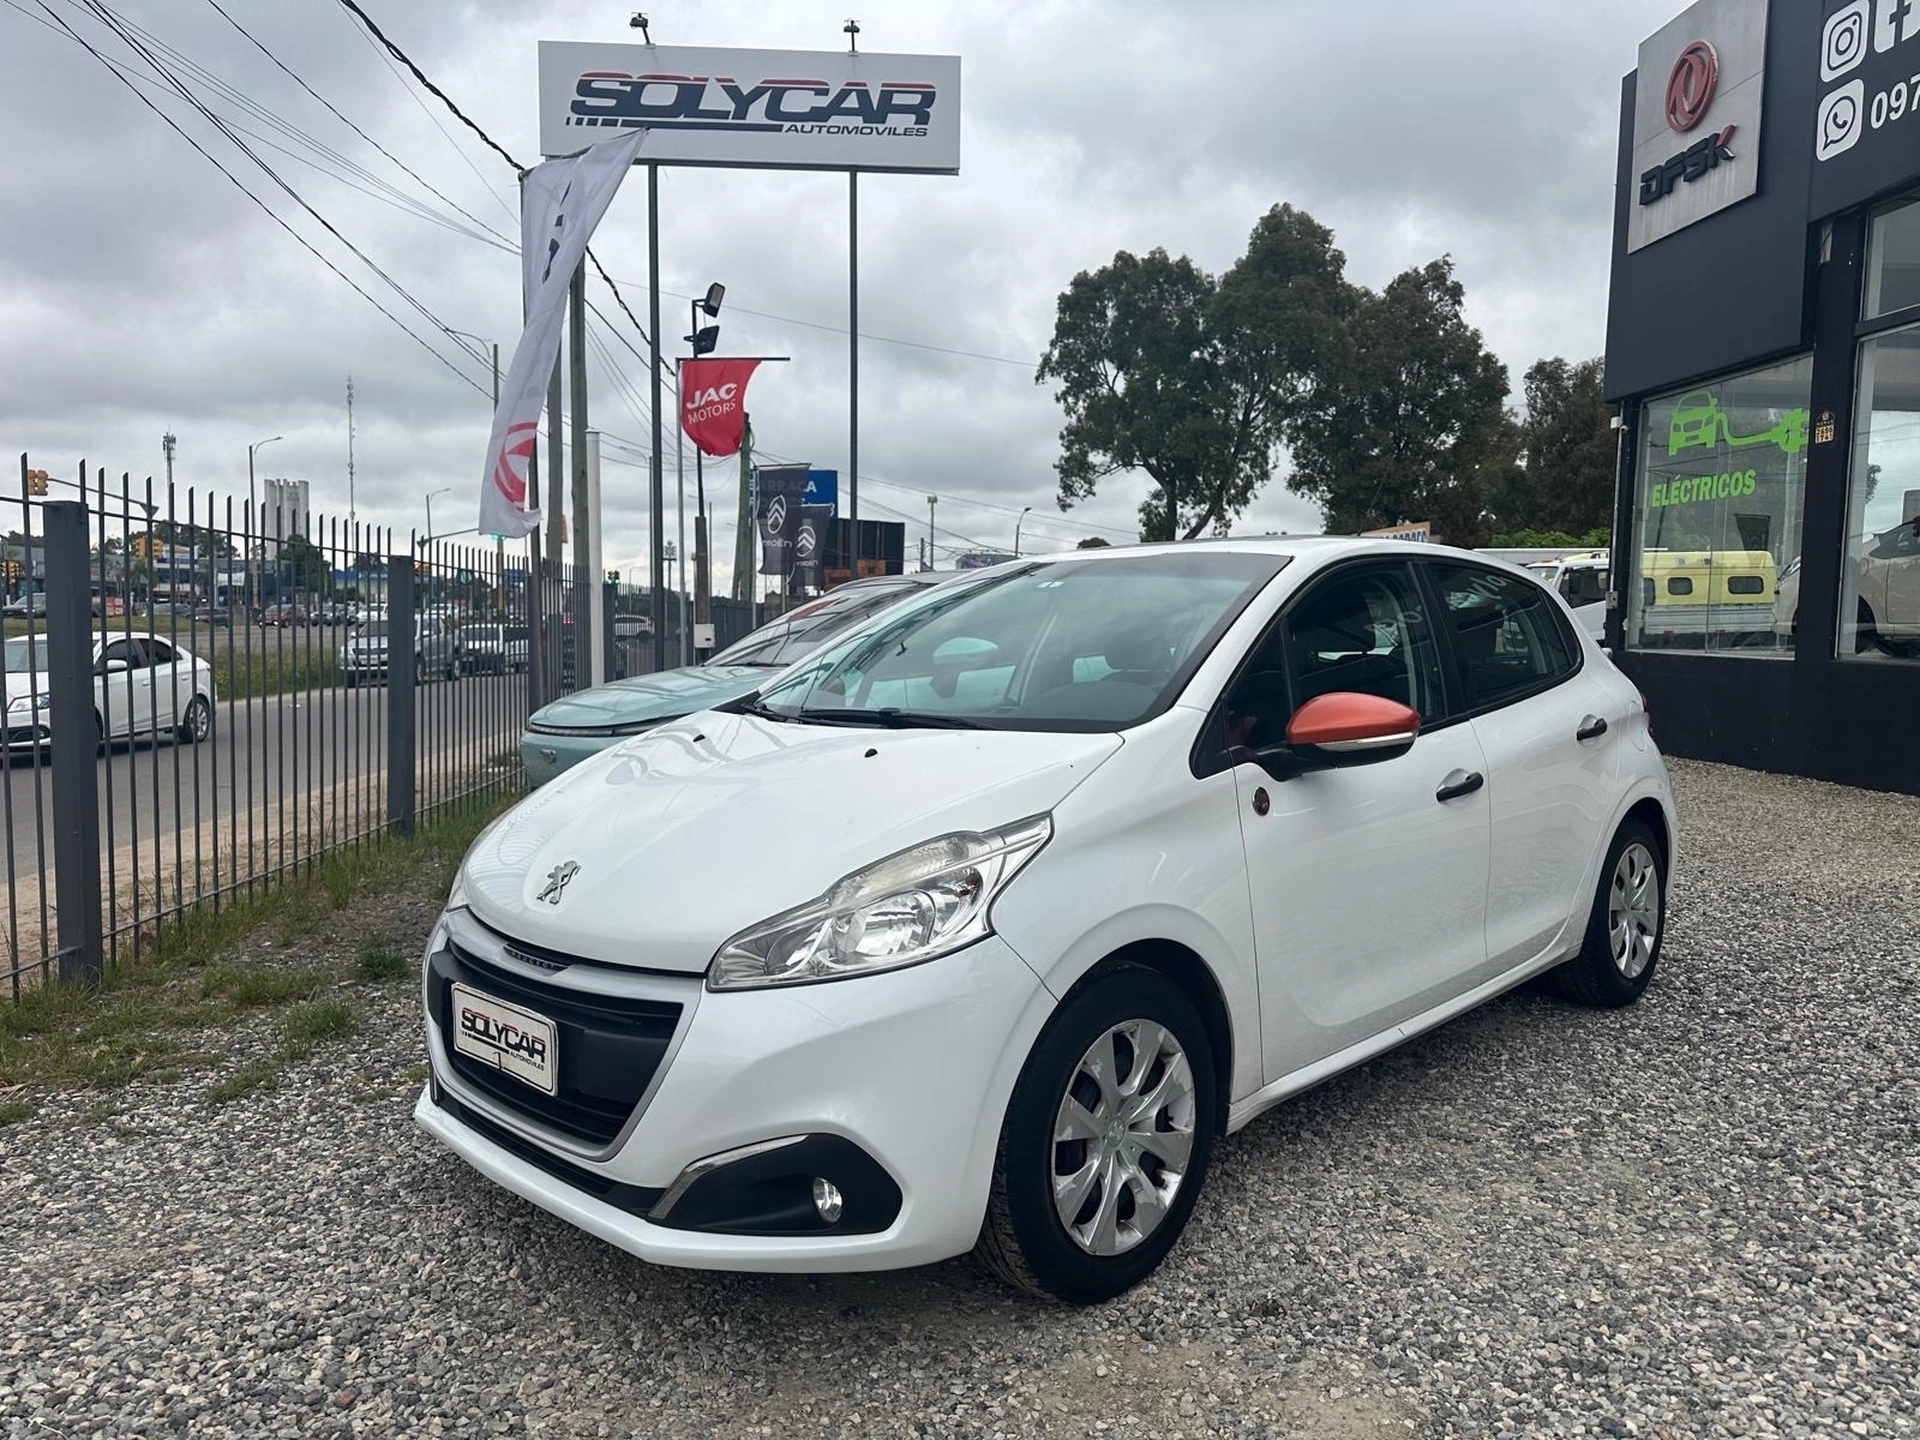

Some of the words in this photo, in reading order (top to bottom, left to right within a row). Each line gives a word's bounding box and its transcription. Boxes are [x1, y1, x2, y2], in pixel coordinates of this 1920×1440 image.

[569, 71, 937, 126] SOLYCAR
[1869, 73, 1920, 129] 097
[784, 123, 928, 137] AUTOMOVILES
[1639, 124, 1738, 206] DFSK
[685, 382, 738, 410] JAC
[687, 400, 737, 425] MOTORS
[1651, 468, 1757, 508] ELÉCTRICOS
[461, 1006, 547, 1064] SOLYCAR
